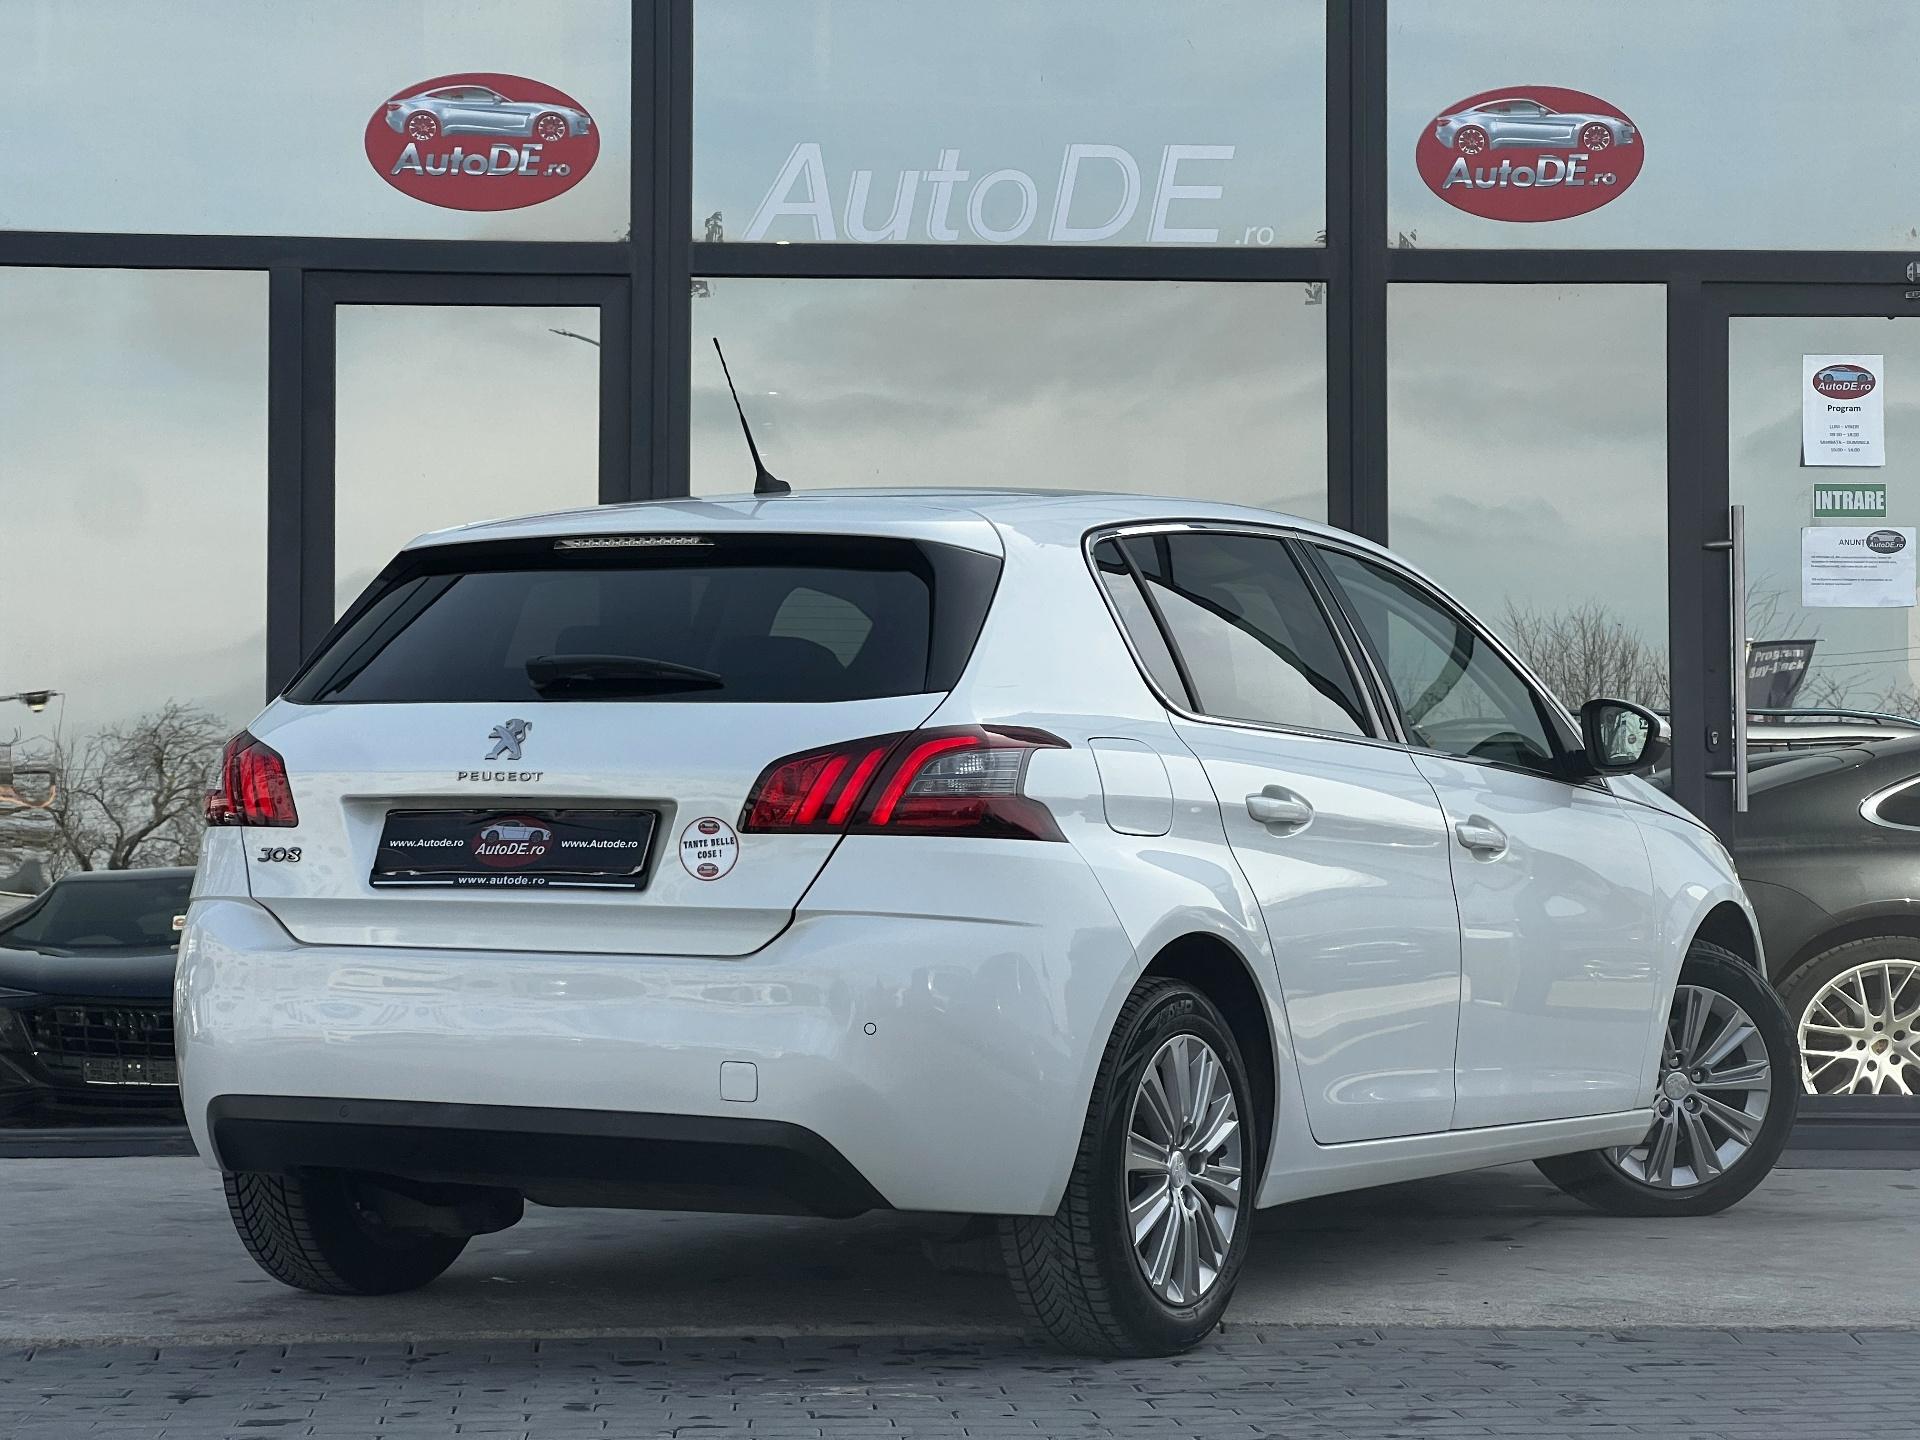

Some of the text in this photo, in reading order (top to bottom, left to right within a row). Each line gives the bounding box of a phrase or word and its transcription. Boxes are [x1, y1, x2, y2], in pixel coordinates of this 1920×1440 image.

[1817, 382, 1872, 392] AutoDE.ro
[1827, 404, 1861, 414] Program
[1815, 490, 1885, 510] INTRARE
[1754, 649, 1805, 662] Program
[457, 771, 544, 782] PEUGEOT
[389, 838, 465, 848] www.Autode.ro
[561, 839, 638, 849] www.Autode.ro
[683, 836, 735, 850] TANTE BELLE
[474, 842, 546, 856] AutoDE.ro
[697, 850, 718, 859] COSE
[257, 847, 302, 863] 308
[458, 875, 546, 886] www.autode.ro
